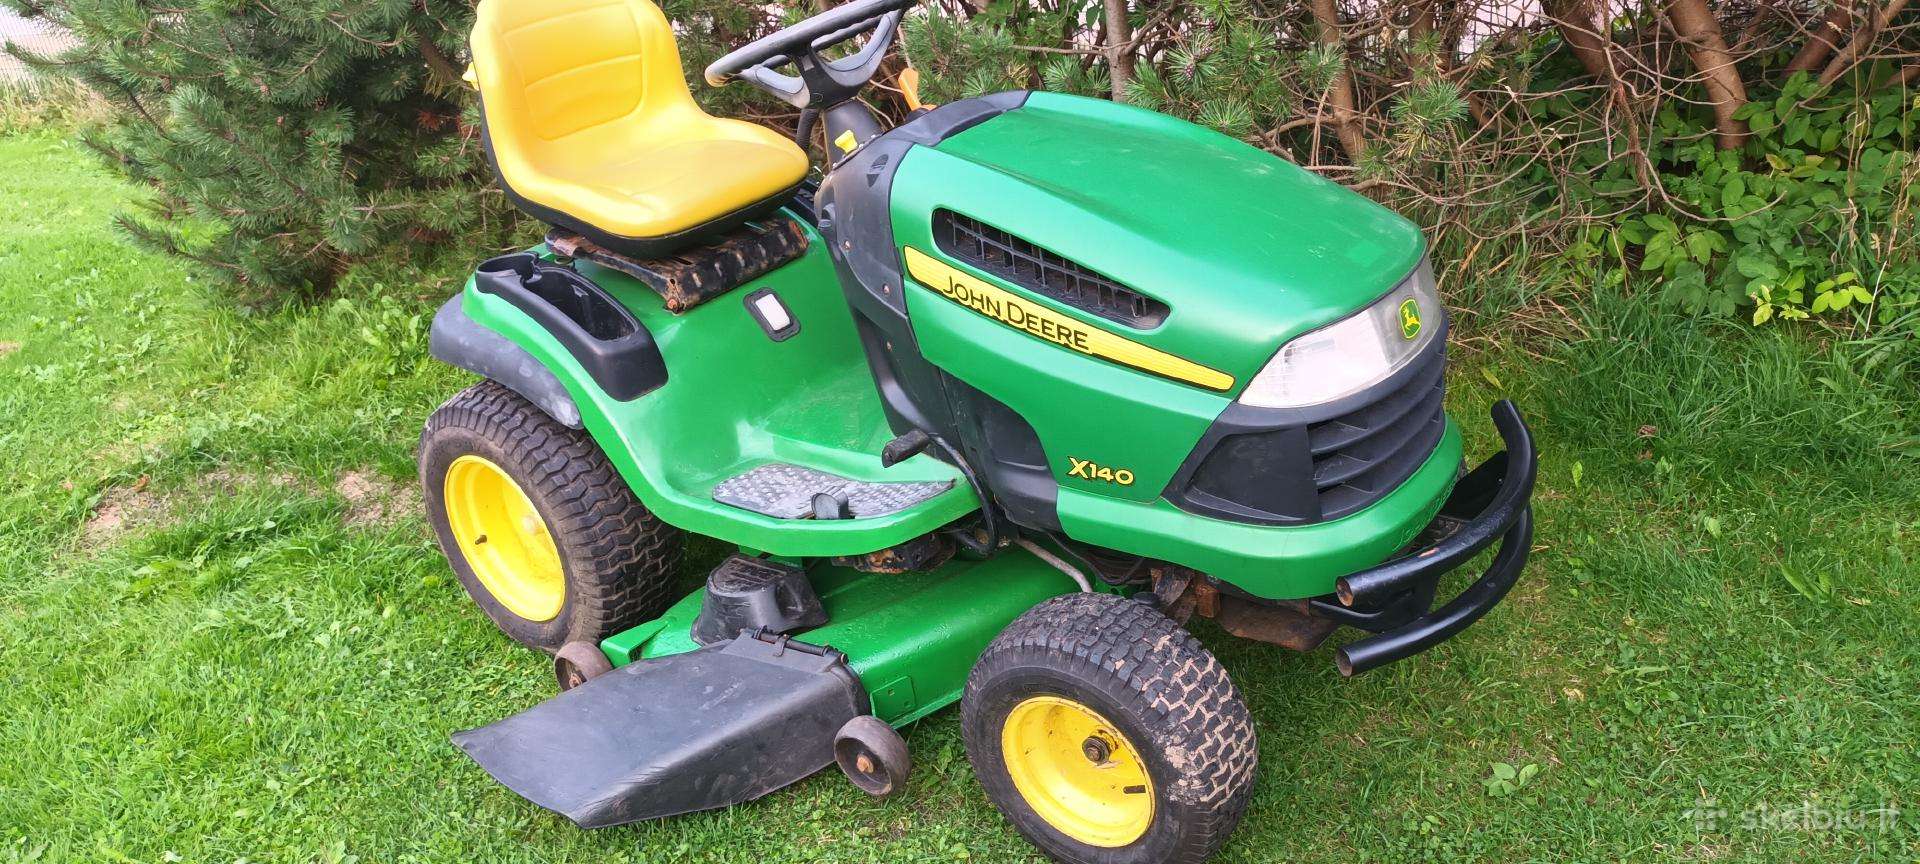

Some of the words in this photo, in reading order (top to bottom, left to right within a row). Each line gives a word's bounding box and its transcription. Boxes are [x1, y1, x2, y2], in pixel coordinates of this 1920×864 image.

[943, 275, 1001, 317] JOHN
[1007, 300, 1089, 350] DEERE
[1067, 455, 1134, 486] X140
